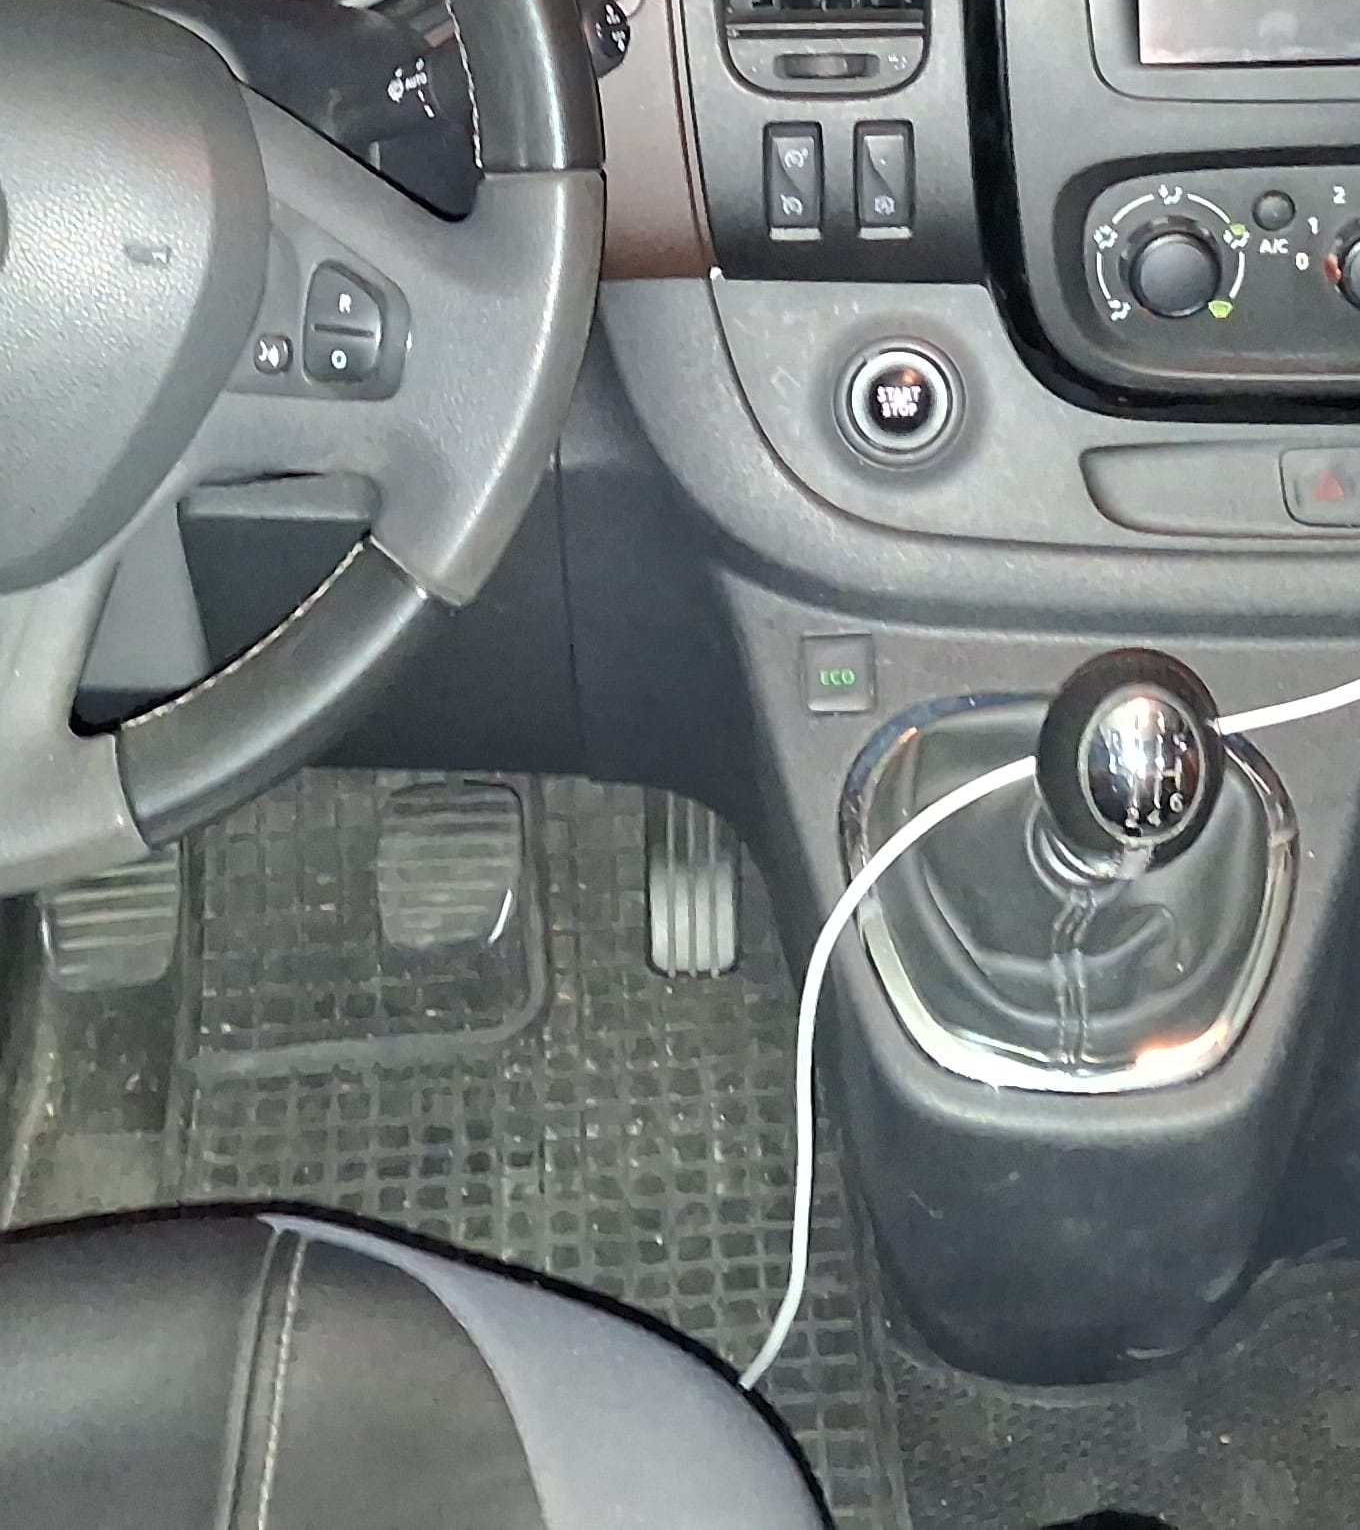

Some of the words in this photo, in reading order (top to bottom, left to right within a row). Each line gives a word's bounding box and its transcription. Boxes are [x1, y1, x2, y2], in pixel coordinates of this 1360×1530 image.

[1332, 185, 1346, 204] 2
[1307, 216, 1319, 235] 1
[1259, 237, 1289, 254] A/C
[1295, 251, 1310, 271] 0
[339, 293, 352, 314] R
[877, 385, 921, 403] START
[880, 402, 918, 418] STOP
[819, 669, 856, 686] ECO
